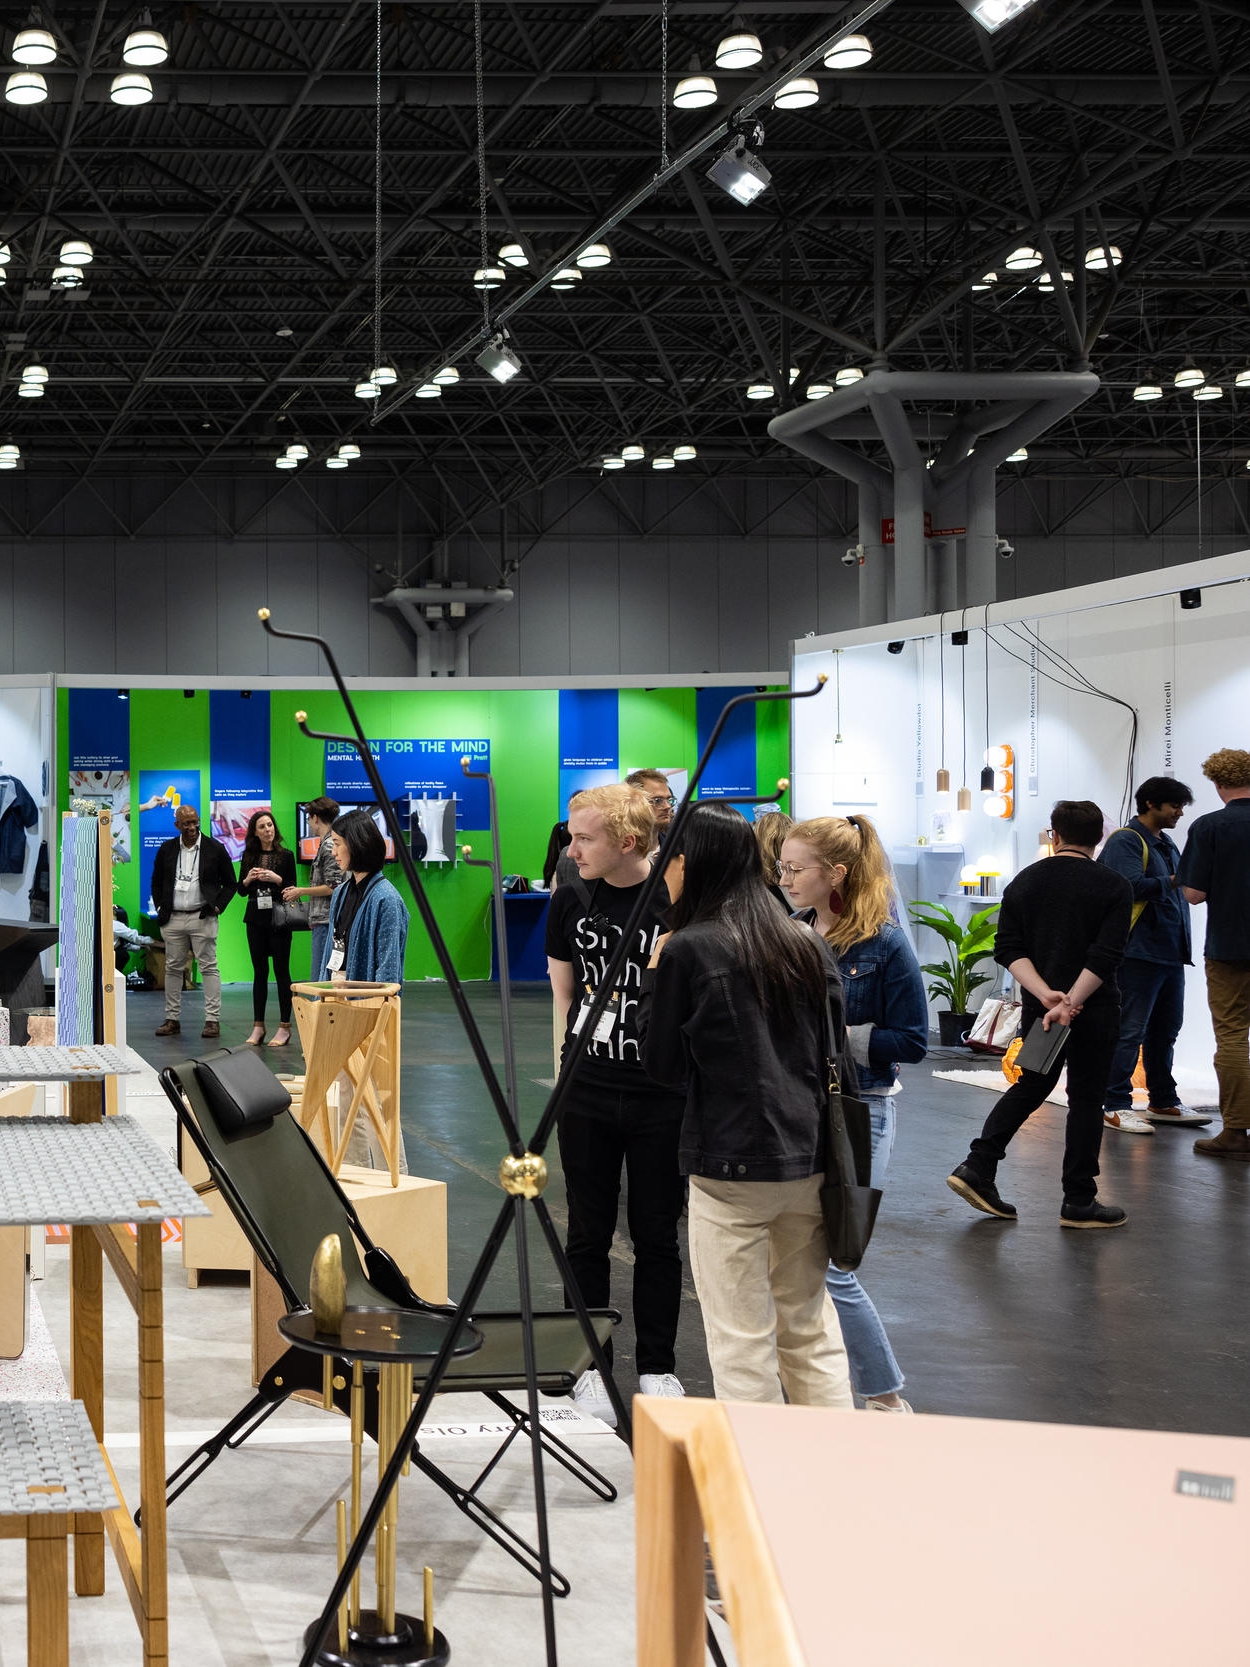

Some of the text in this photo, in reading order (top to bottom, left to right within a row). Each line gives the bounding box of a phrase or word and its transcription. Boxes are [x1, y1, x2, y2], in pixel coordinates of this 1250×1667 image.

[1164, 681, 1172, 768] Mirei Monticelli
[327, 741, 488, 753] DESN FOR THE MIND
[419, 1426, 468, 1437] Ols
